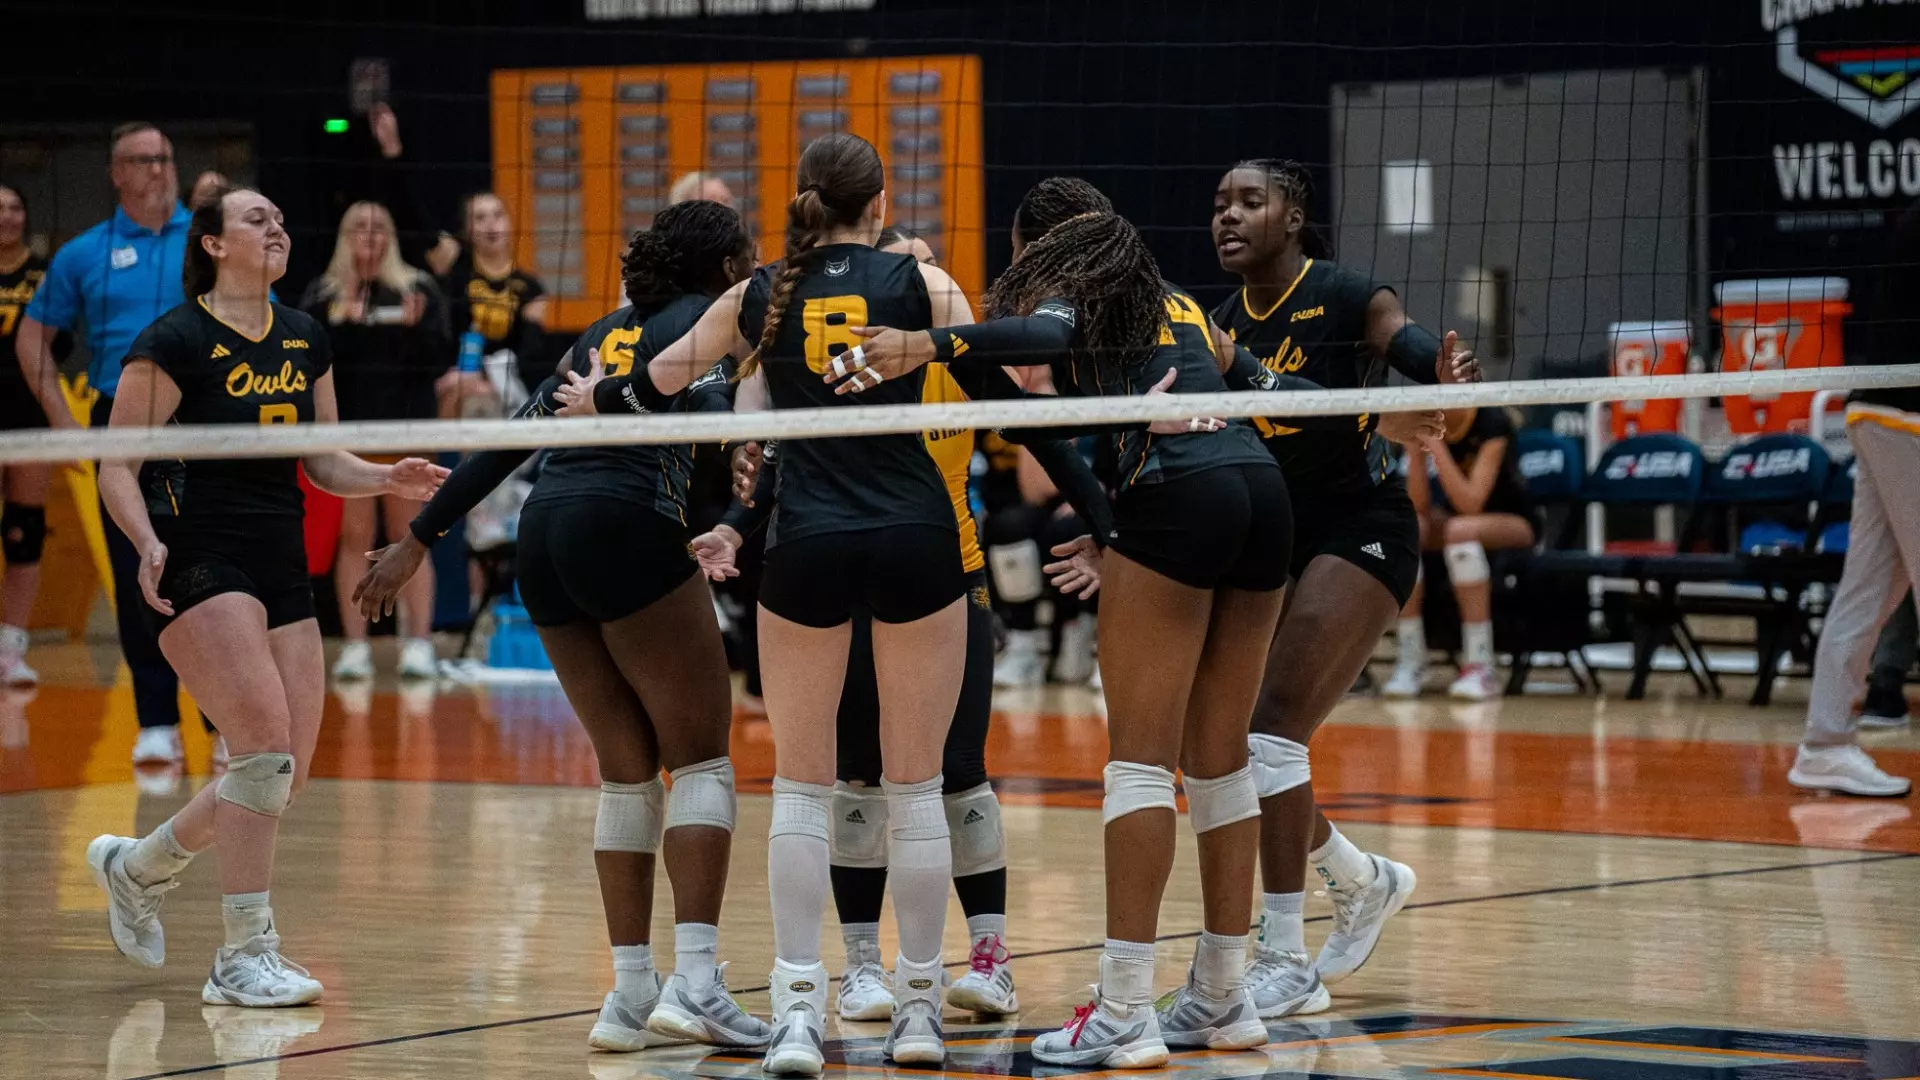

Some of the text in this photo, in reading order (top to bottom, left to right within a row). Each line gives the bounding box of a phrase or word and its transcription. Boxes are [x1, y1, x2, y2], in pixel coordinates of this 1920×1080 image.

[1772, 138, 1920, 200] WELCO
[803, 295, 868, 374] 8
[1743, 326, 1779, 364] G
[226, 360, 307, 397] Owls
